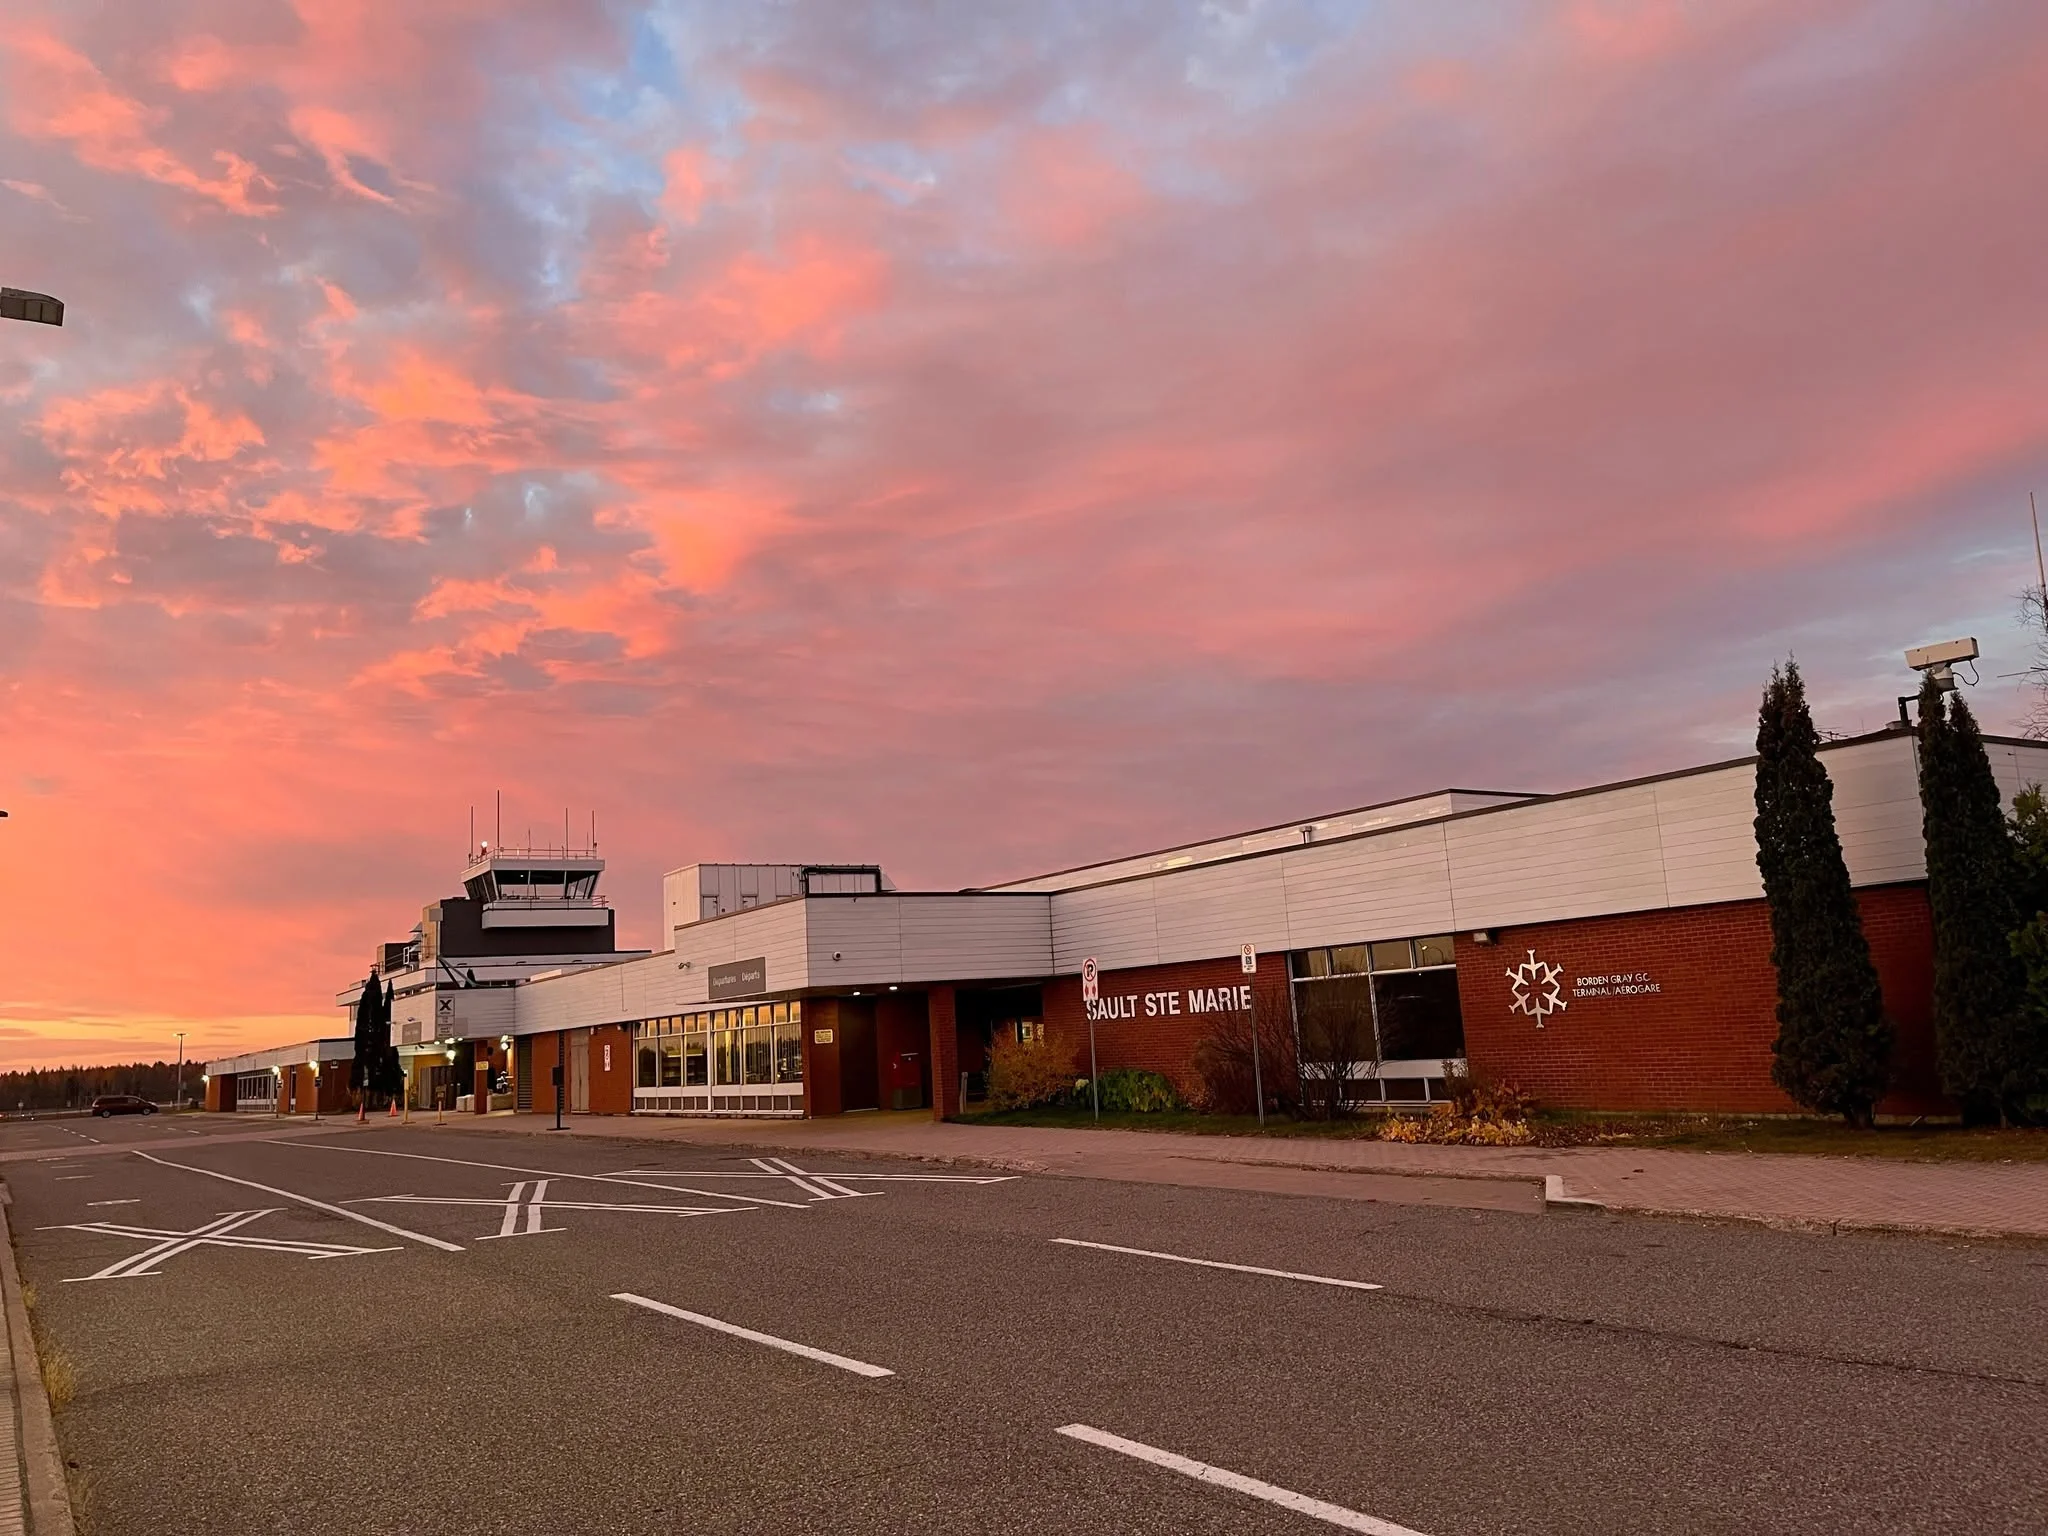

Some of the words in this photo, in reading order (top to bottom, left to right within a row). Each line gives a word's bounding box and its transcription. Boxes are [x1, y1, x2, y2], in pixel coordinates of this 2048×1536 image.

[1577, 976, 1609, 986] BORDEN
[1610, 974, 1632, 984] GRAY
[1086, 996, 1138, 1020] SAULT
[1145, 992, 1181, 1016] STE
[1188, 985, 1251, 1014] MARIE
